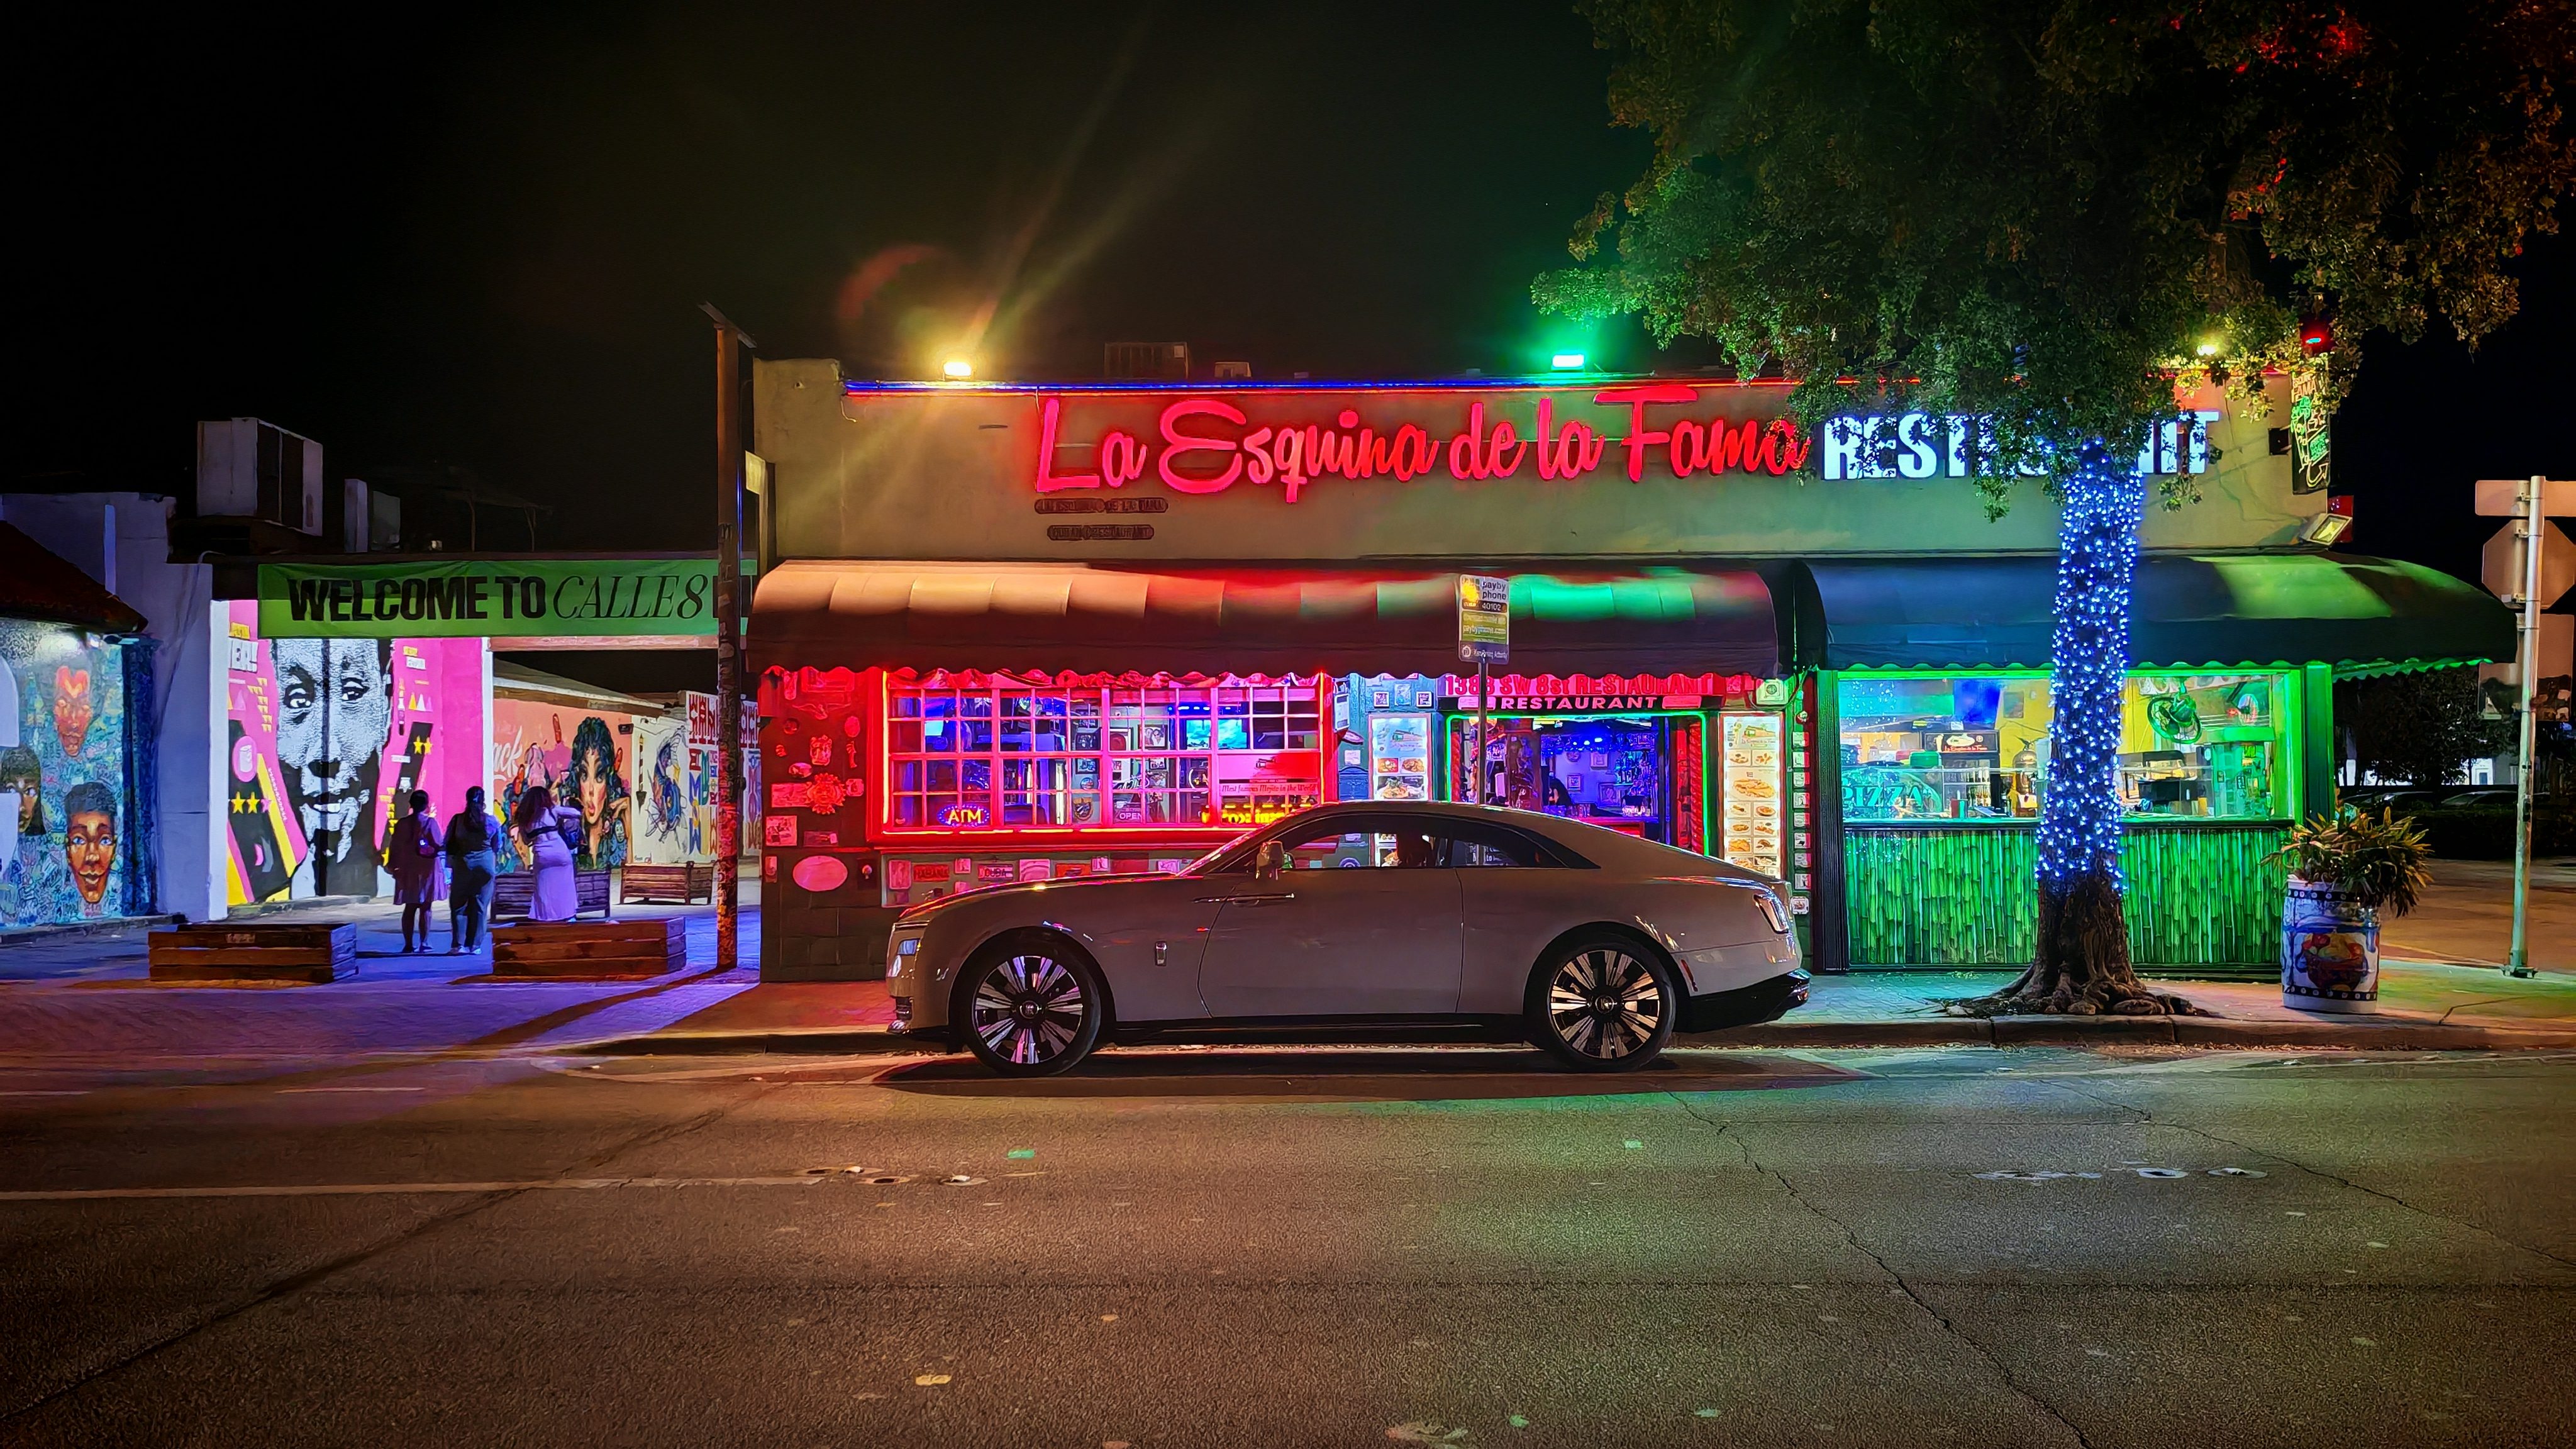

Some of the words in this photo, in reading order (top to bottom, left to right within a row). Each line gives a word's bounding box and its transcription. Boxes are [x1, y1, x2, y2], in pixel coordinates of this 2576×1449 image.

[1036, 398, 1147, 492] La
[1158, 399, 1439, 503] Esquina
[1449, 402, 1527, 480] de
[1537, 397, 1605, 480] la
[1594, 386, 1811, 483] Fama
[1824, 410, 2219, 480] RESTNT
[287, 576, 488, 621] WELCOME
[496, 575, 546, 619] TO
[1482, 591, 1506, 601] phone
[1482, 602, 1501, 611] 40102
[1446, 676, 1495, 695] 1388
[1500, 675, 1531, 695] SW
[1577, 675, 1713, 695] RESTAURANT
[1501, 697, 1657, 709] RESTAURANT
[1841, 786, 1923, 807] PIZZA
[948, 808, 982, 824] ATM
[984, 868, 1006, 877] CUBA
